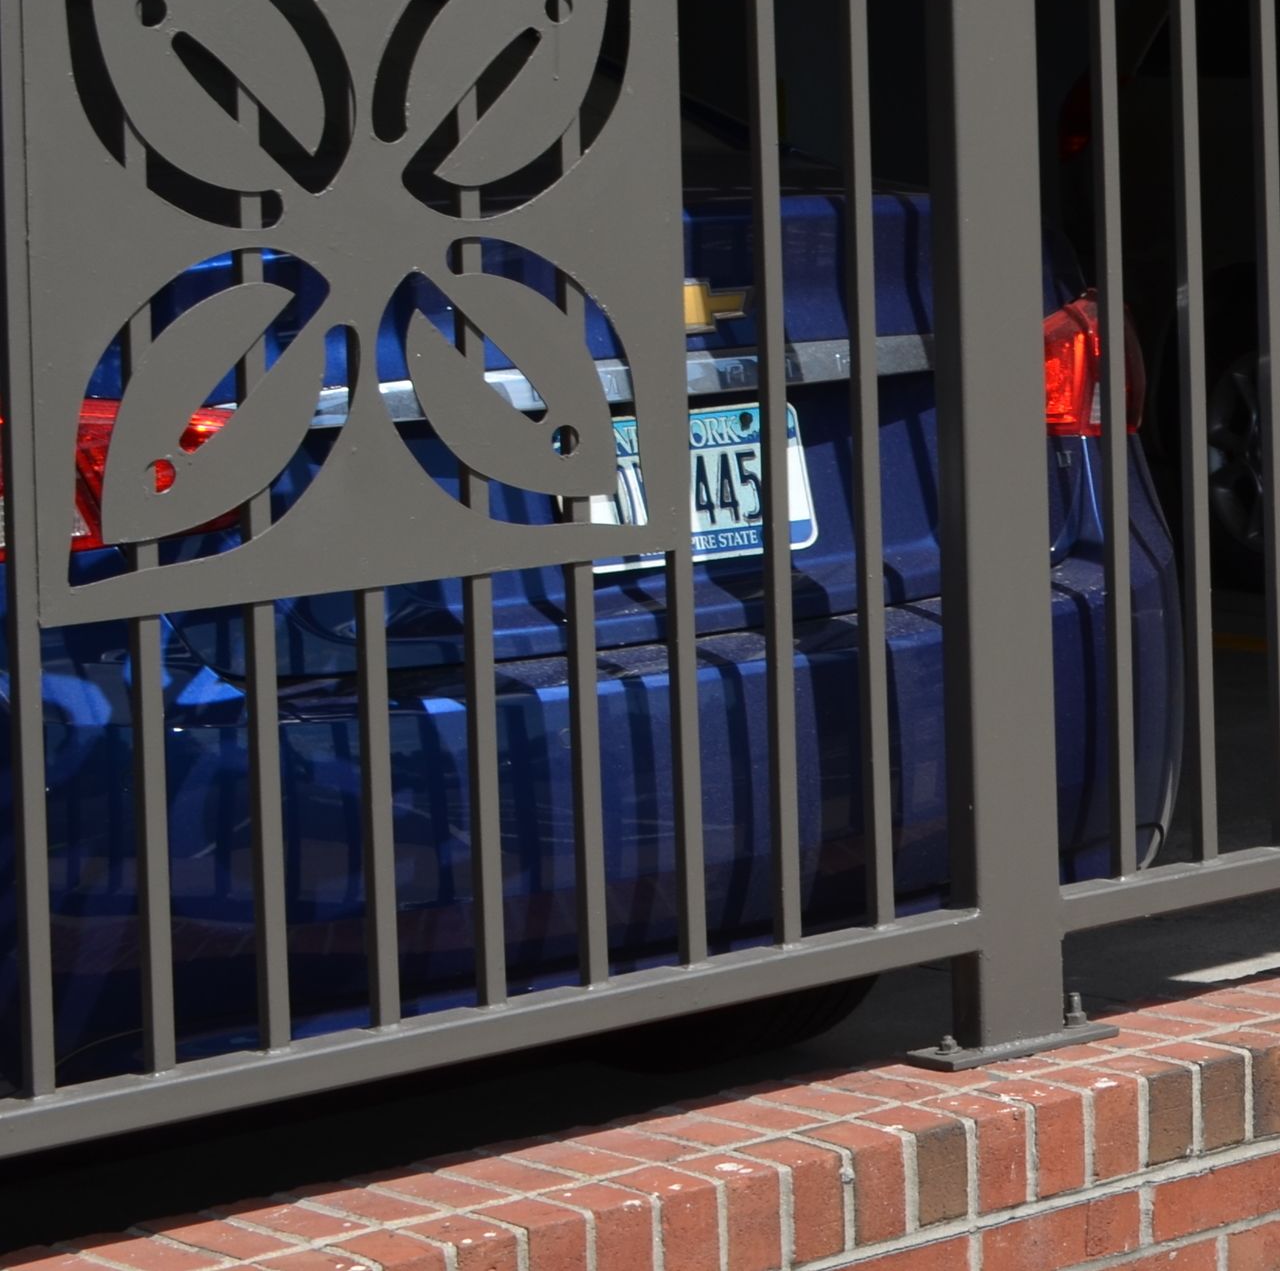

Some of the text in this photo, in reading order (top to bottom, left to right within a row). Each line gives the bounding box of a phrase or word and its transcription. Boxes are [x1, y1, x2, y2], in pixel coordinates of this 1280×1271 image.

[690, 416, 741, 448] ORK
[695, 449, 762, 524] 445
[718, 530, 758, 548] STATE
